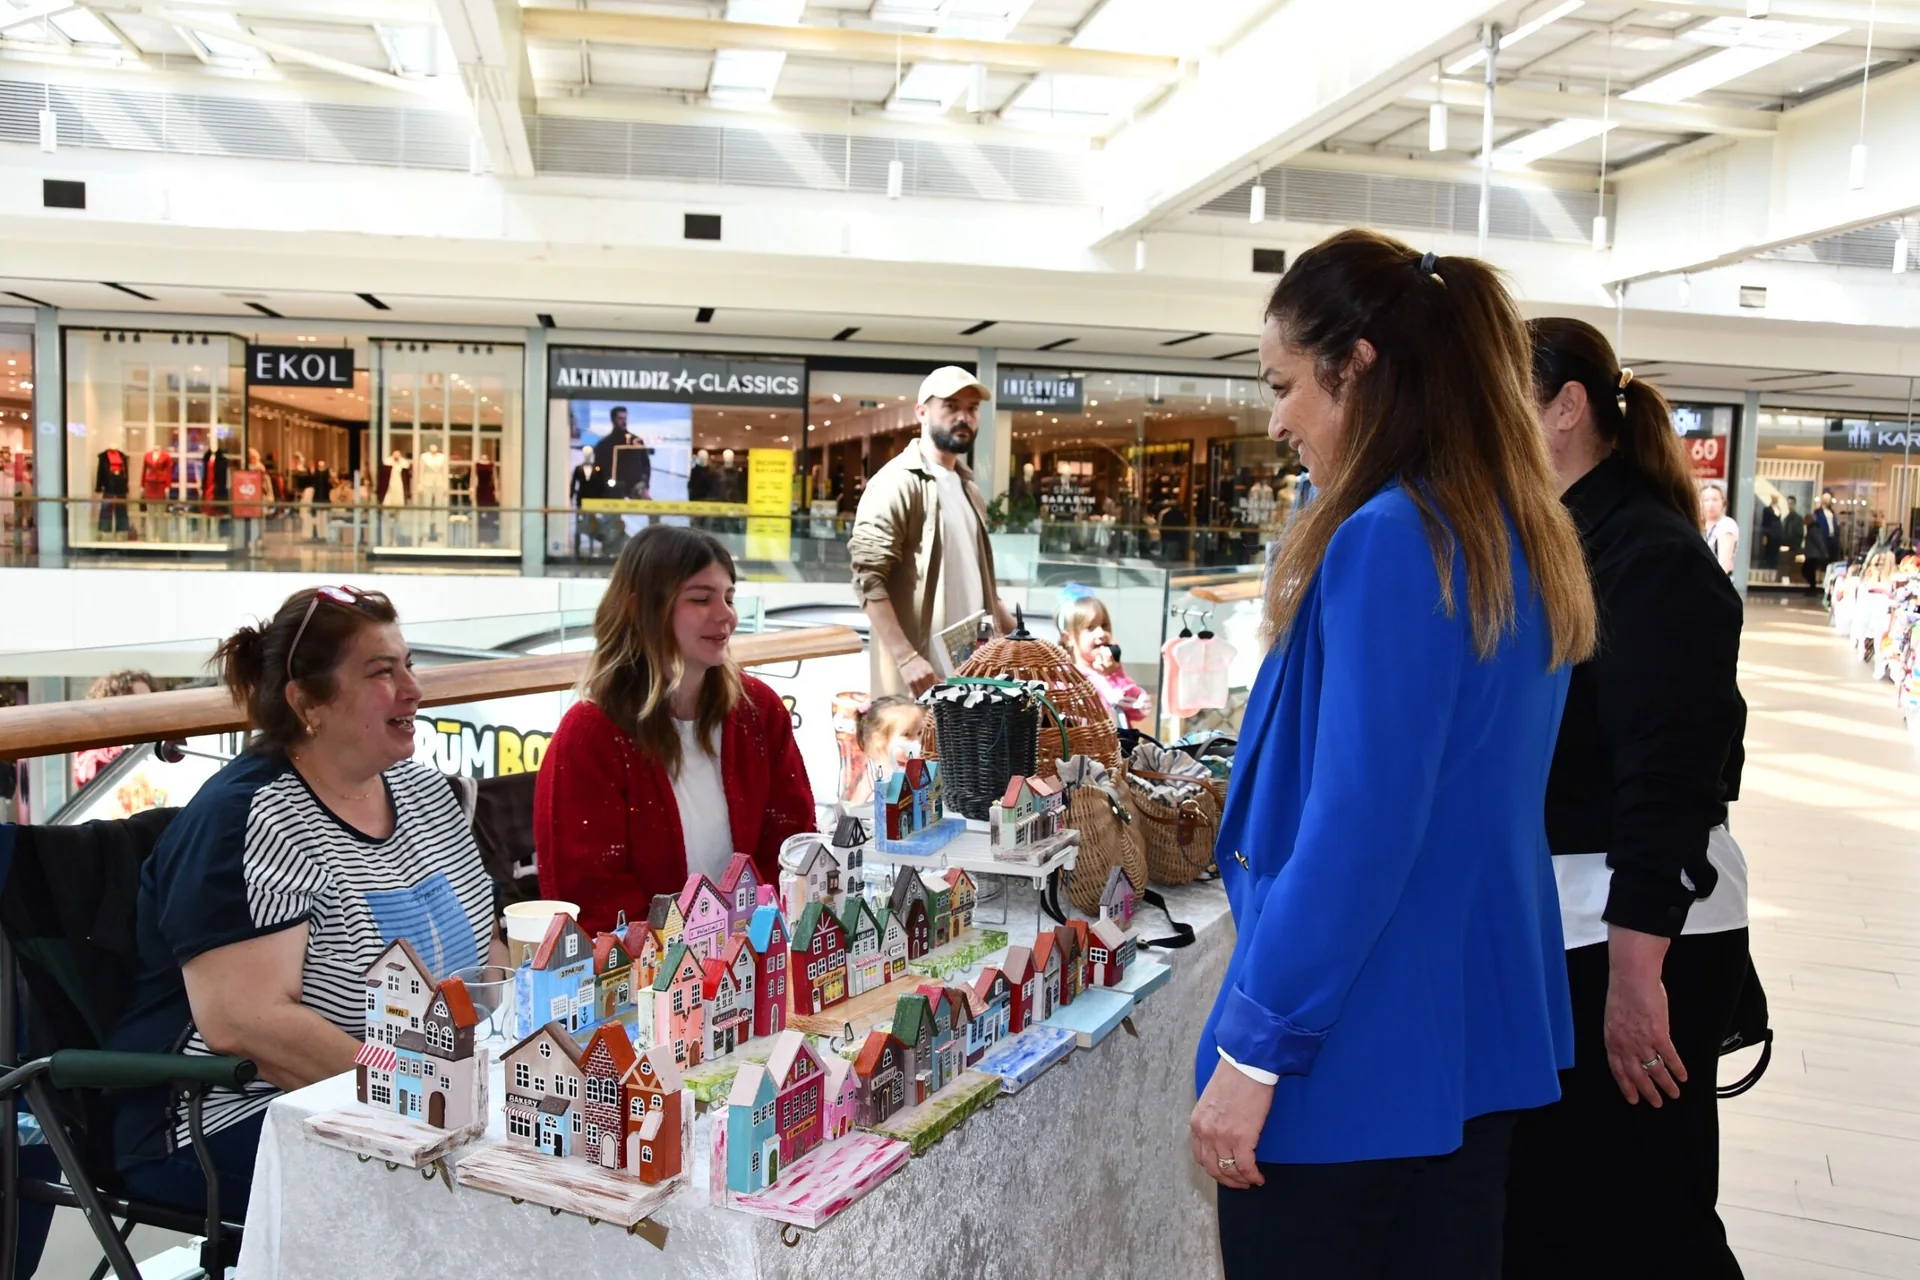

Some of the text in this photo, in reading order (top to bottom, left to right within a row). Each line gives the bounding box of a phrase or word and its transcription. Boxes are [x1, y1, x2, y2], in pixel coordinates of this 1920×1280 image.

[256, 352, 348, 382] EKOL
[556, 367, 799, 395] ALTINYILDIZ CLASSICS
[1691, 438, 1719, 461] 60
[388, 1007, 406, 1018] HOTEL
[508, 1094, 538, 1108] BAKERY
